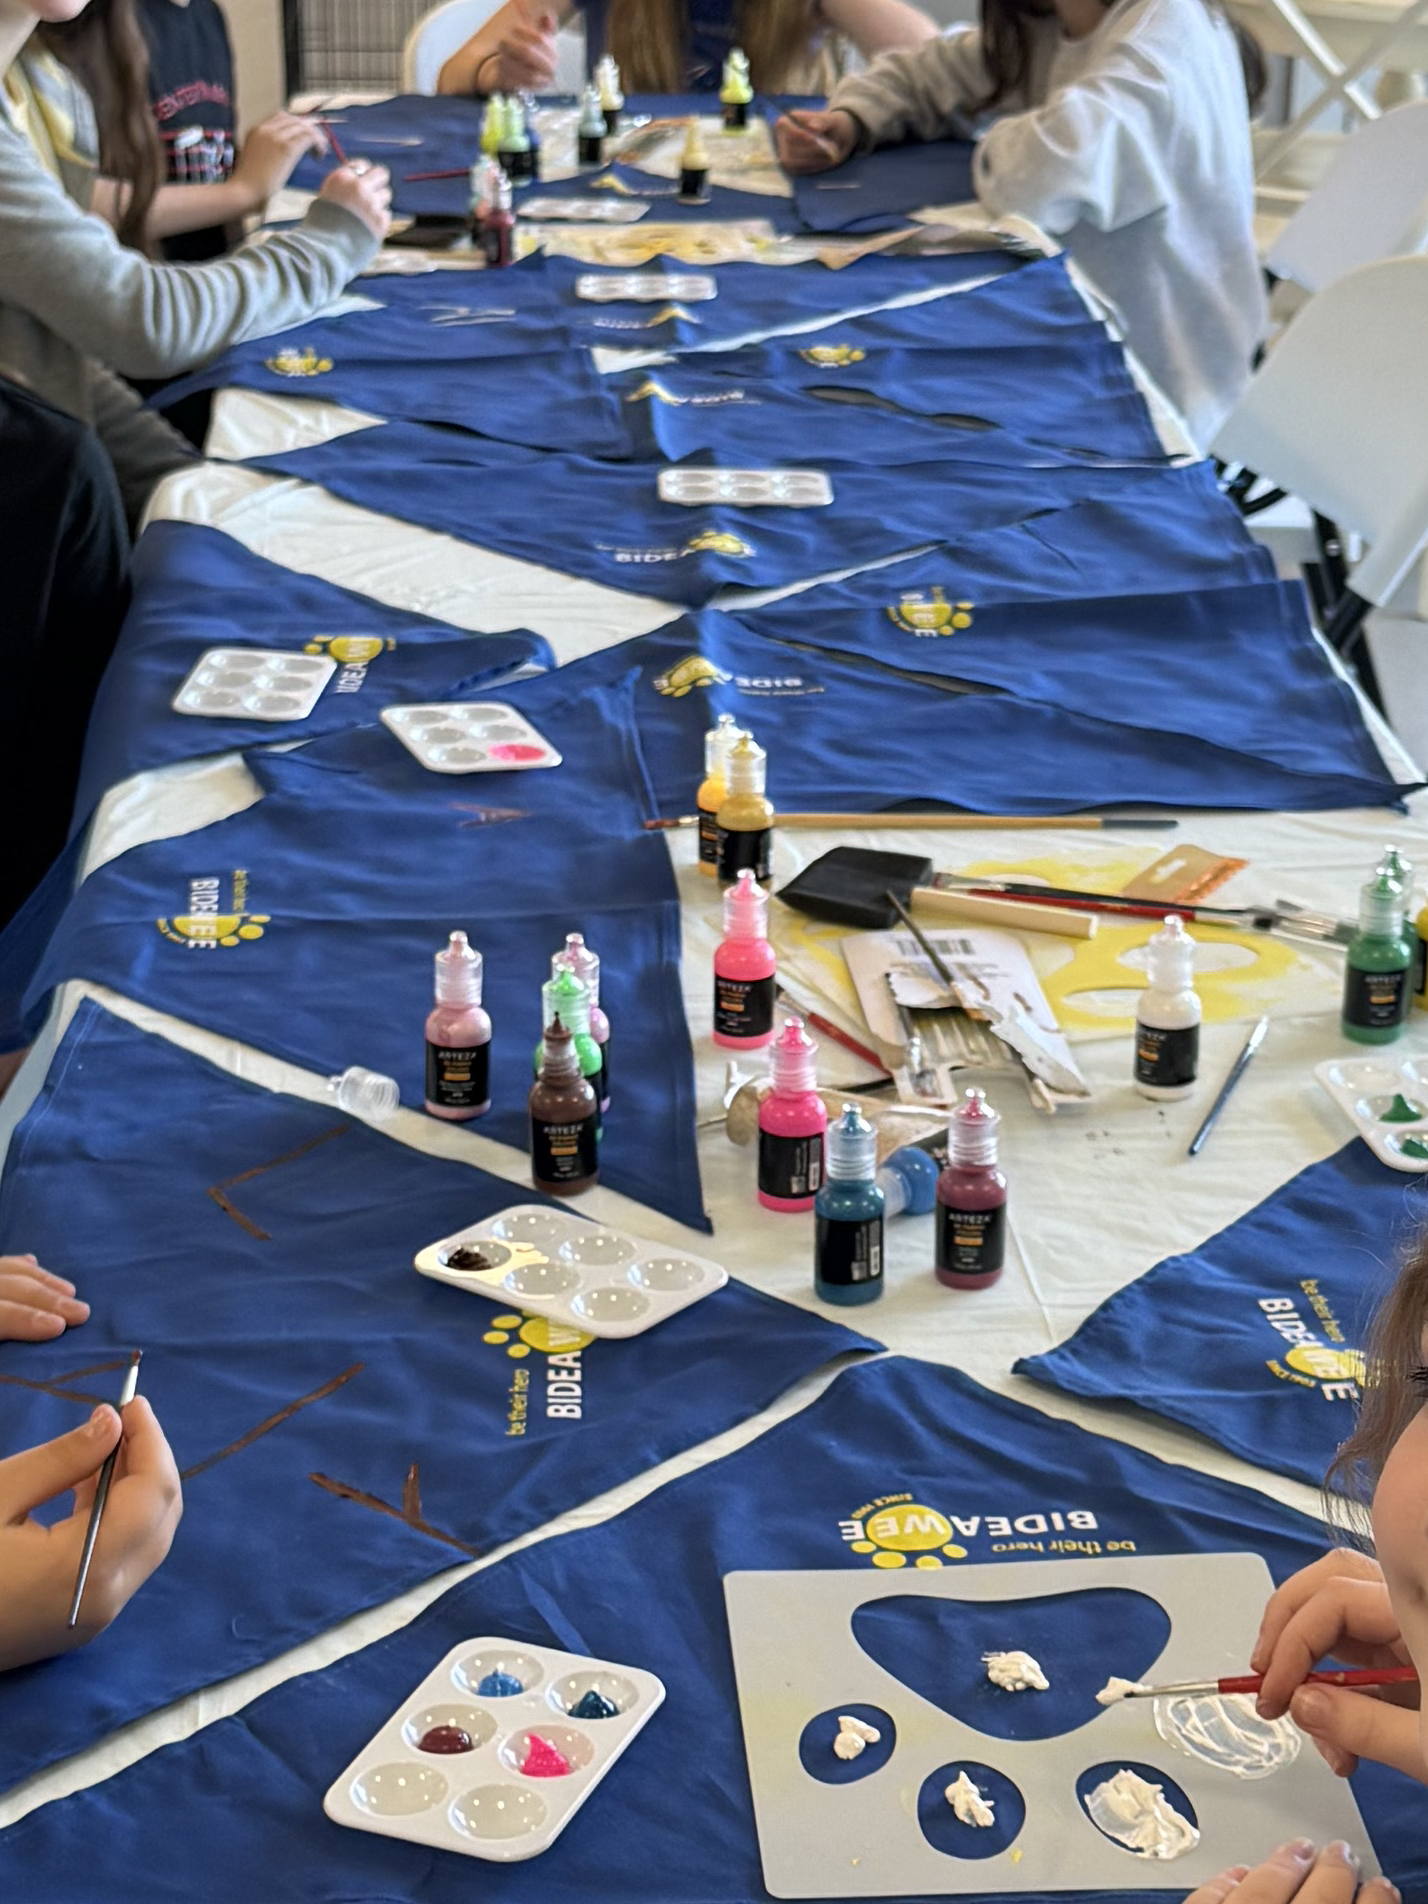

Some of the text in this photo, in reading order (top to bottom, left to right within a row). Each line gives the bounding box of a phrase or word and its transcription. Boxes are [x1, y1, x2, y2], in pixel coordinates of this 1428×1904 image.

[546, 1318, 583, 1420] BIDEAW
[506, 1393, 529, 1422] their
[505, 1421, 527, 1437] be
[838, 1510, 1099, 1542] BIDEAWEE
[992, 1539, 1137, 1555] be their hero
